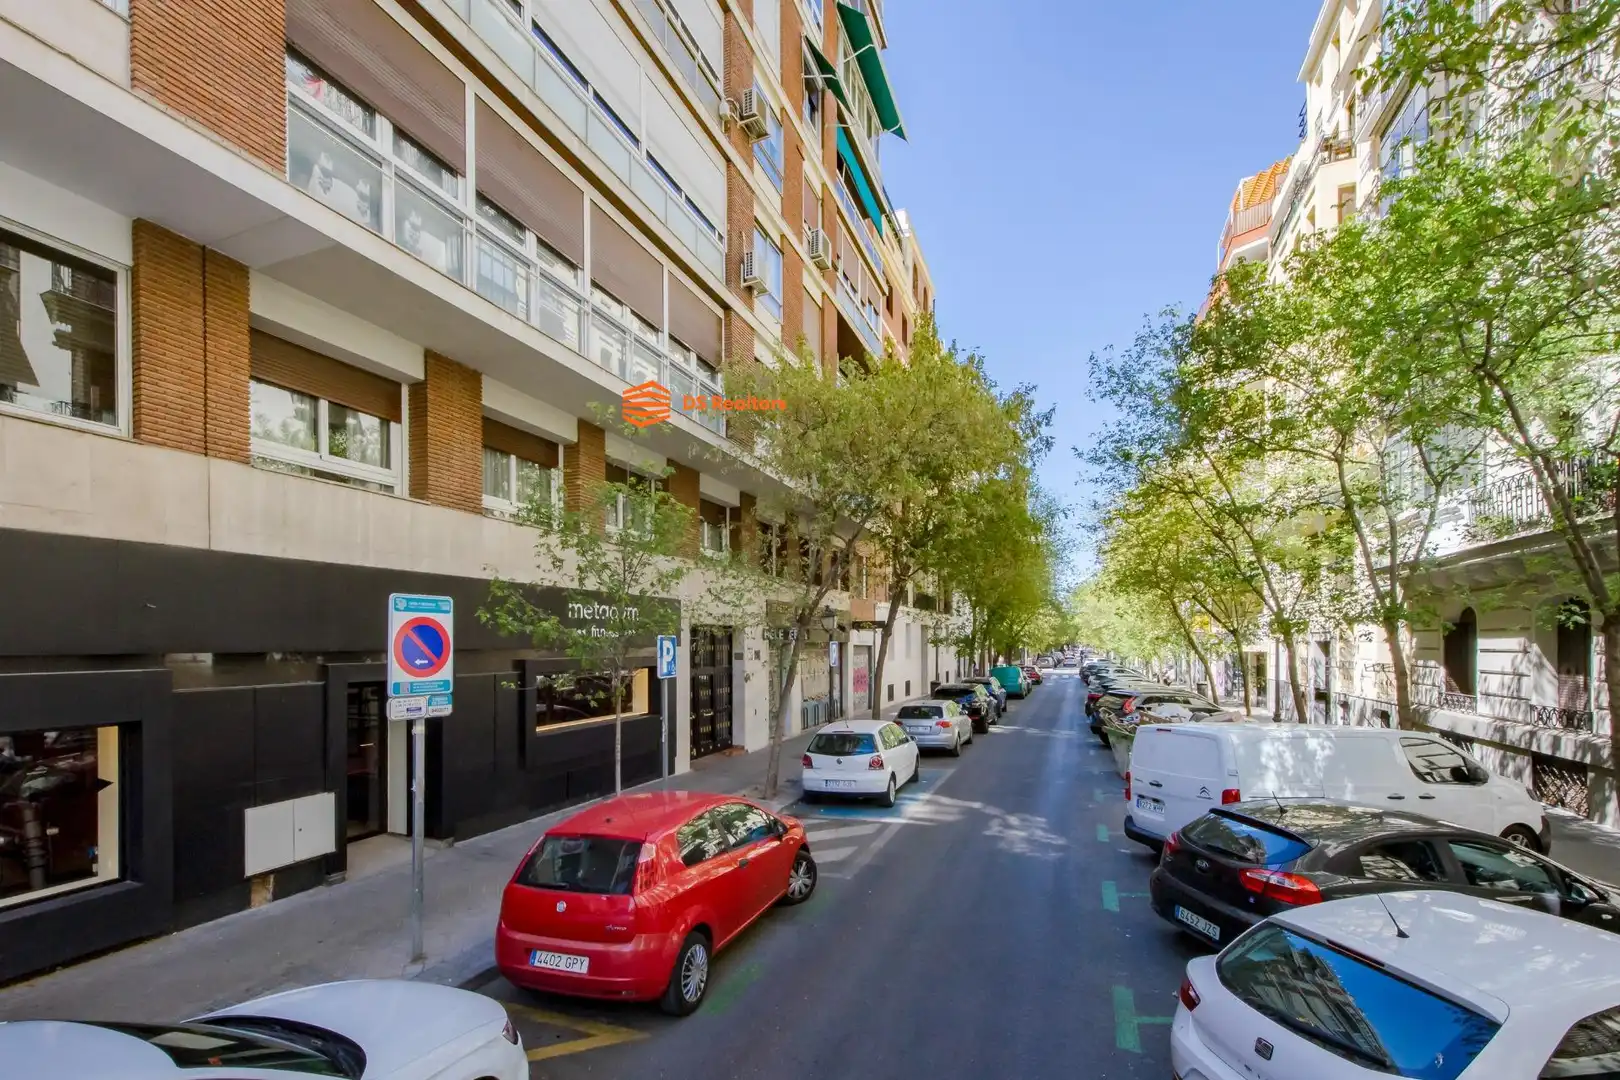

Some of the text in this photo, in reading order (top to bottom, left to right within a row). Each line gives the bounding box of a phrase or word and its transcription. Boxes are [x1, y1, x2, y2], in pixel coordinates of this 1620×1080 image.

[662, 640, 674, 673] P
[1202, 919, 1218, 938] JZS
[537, 953, 586, 971] 4402 GPY
